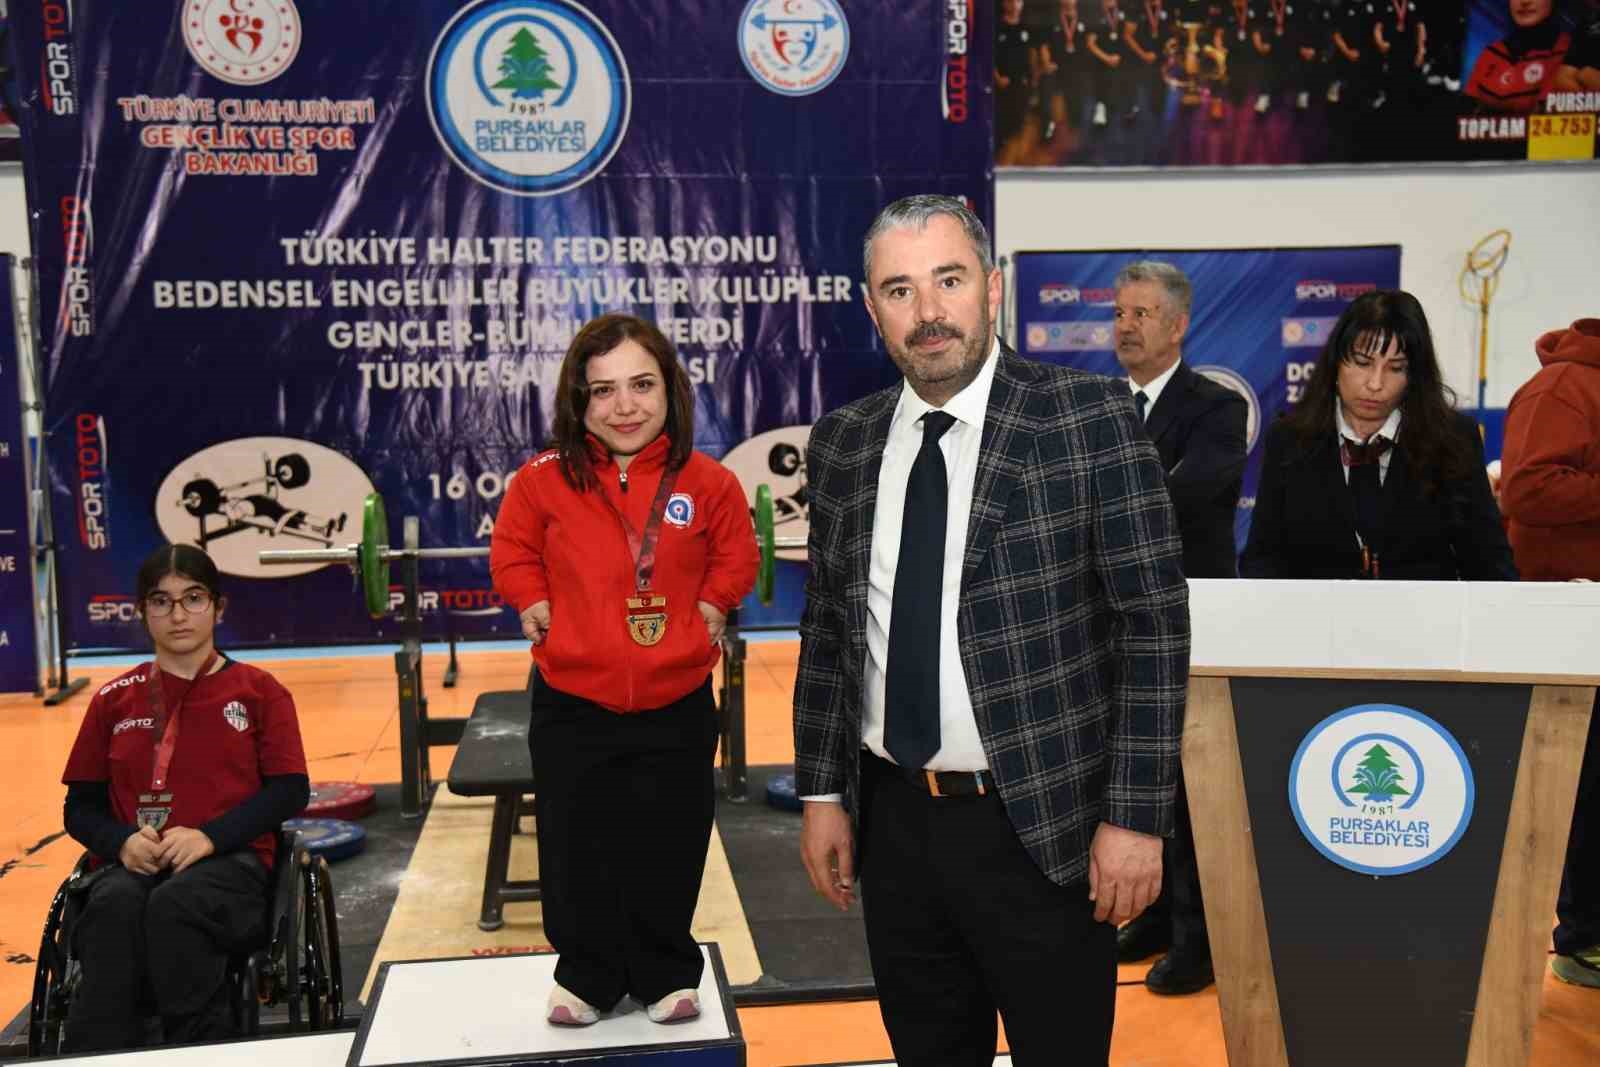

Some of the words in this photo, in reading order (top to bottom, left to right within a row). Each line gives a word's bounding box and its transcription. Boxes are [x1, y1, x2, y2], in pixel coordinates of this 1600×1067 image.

[948, 0, 968, 55] POR
[48, 42, 73, 115] SPOR
[949, 56, 967, 123] TOTO
[119, 94, 216, 121] TÜRKİYE
[218, 97, 375, 123] CUMHURİYETİ
[141, 122, 250, 153] GENÇLİK
[252, 127, 285, 149] VE
[288, 127, 355, 150] SPOR
[475, 119, 586, 136] PURSAKLAR
[1459, 118, 1526, 140] TOPLAM
[475, 135, 587, 153] BELEDİYESİ
[185, 150, 318, 176] BAKANLIĞI
[280, 230, 416, 266] TÜRKİYE
[427, 237, 545, 264] HALTER
[554, 235, 777, 264] FEDERASYONU
[68, 267, 91, 337] SPOR
[153, 279, 321, 309] BEDENSEL
[529, 271, 689, 305] BÜYÜKLER
[699, 270, 852, 303] KULÜPLER
[357, 354, 490, 390] TÜRKİYE
[76, 413, 98, 481] TOTO
[428, 472, 467, 500] 16
[82, 482, 106, 550] SPOR
[88, 602, 143, 622] SPO
[1360, 803, 1394, 816] 1987
[1329, 817, 1430, 834] PURSAKLAR
[1329, 831, 1430, 849] BELEDİYESİ
